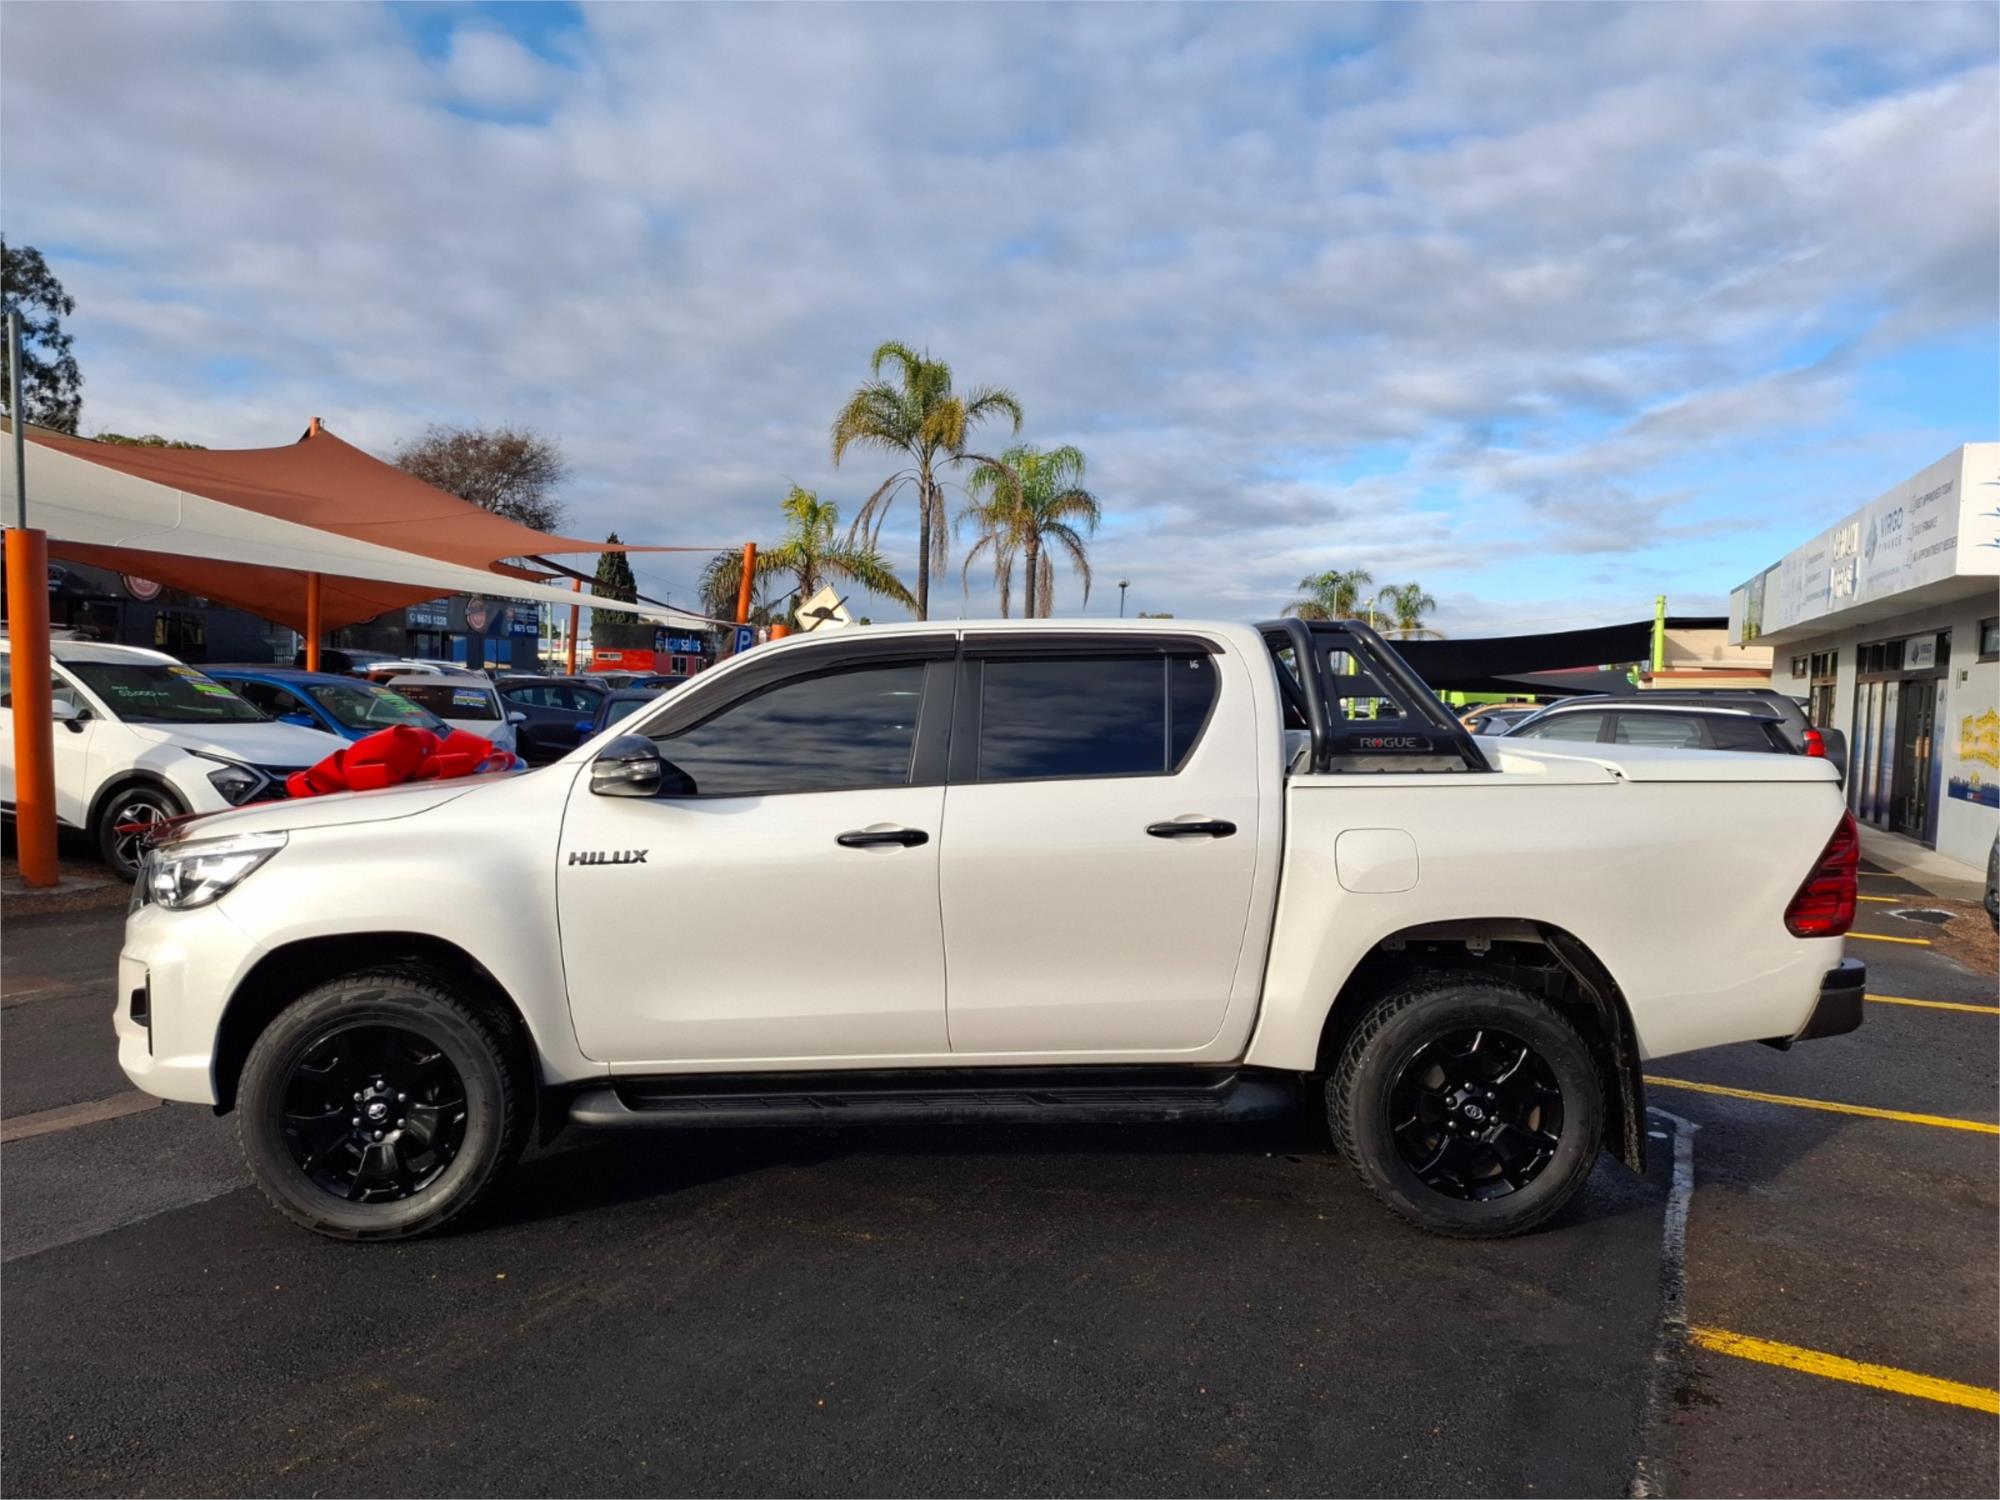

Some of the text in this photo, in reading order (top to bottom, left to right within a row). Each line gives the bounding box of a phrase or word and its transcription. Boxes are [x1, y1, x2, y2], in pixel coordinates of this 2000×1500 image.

[1880, 506, 1903, 538] VIRGO
[738, 630, 751, 653] P
[1360, 737, 1417, 748] ROGUE
[568, 849, 649, 866] HILUX
